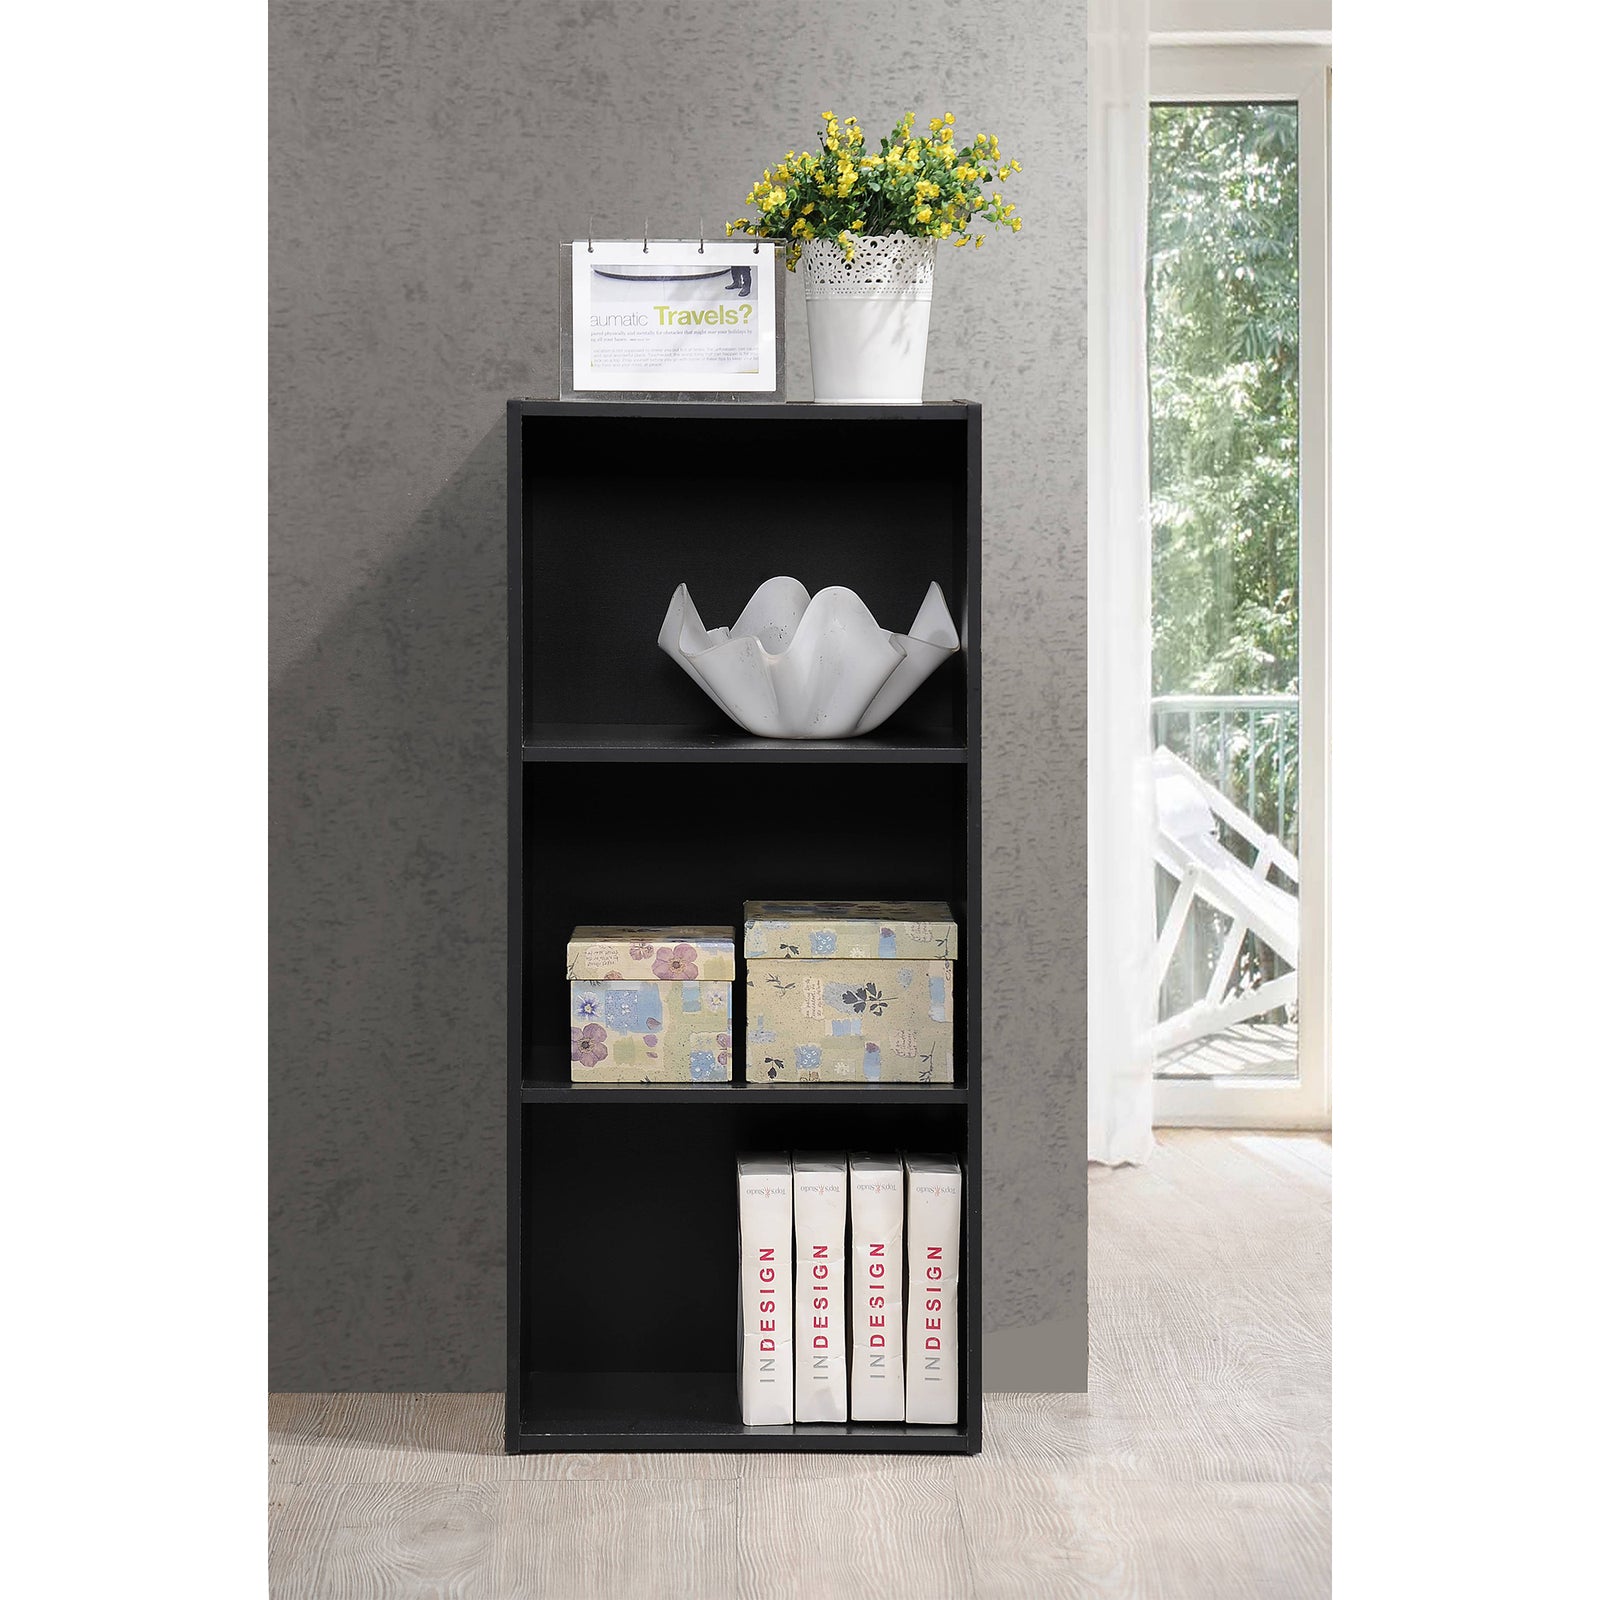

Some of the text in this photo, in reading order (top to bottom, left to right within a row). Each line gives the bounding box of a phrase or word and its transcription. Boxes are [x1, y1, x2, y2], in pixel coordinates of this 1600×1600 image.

[590, 303, 753, 327] aumatic Travels?
[759, 1248, 775, 1382] INDESIGN
[813, 1245, 829, 1379] INDESIGN
[869, 1243, 885, 1378] INDESIGN
[924, 1246, 943, 1381] INDESIGN
